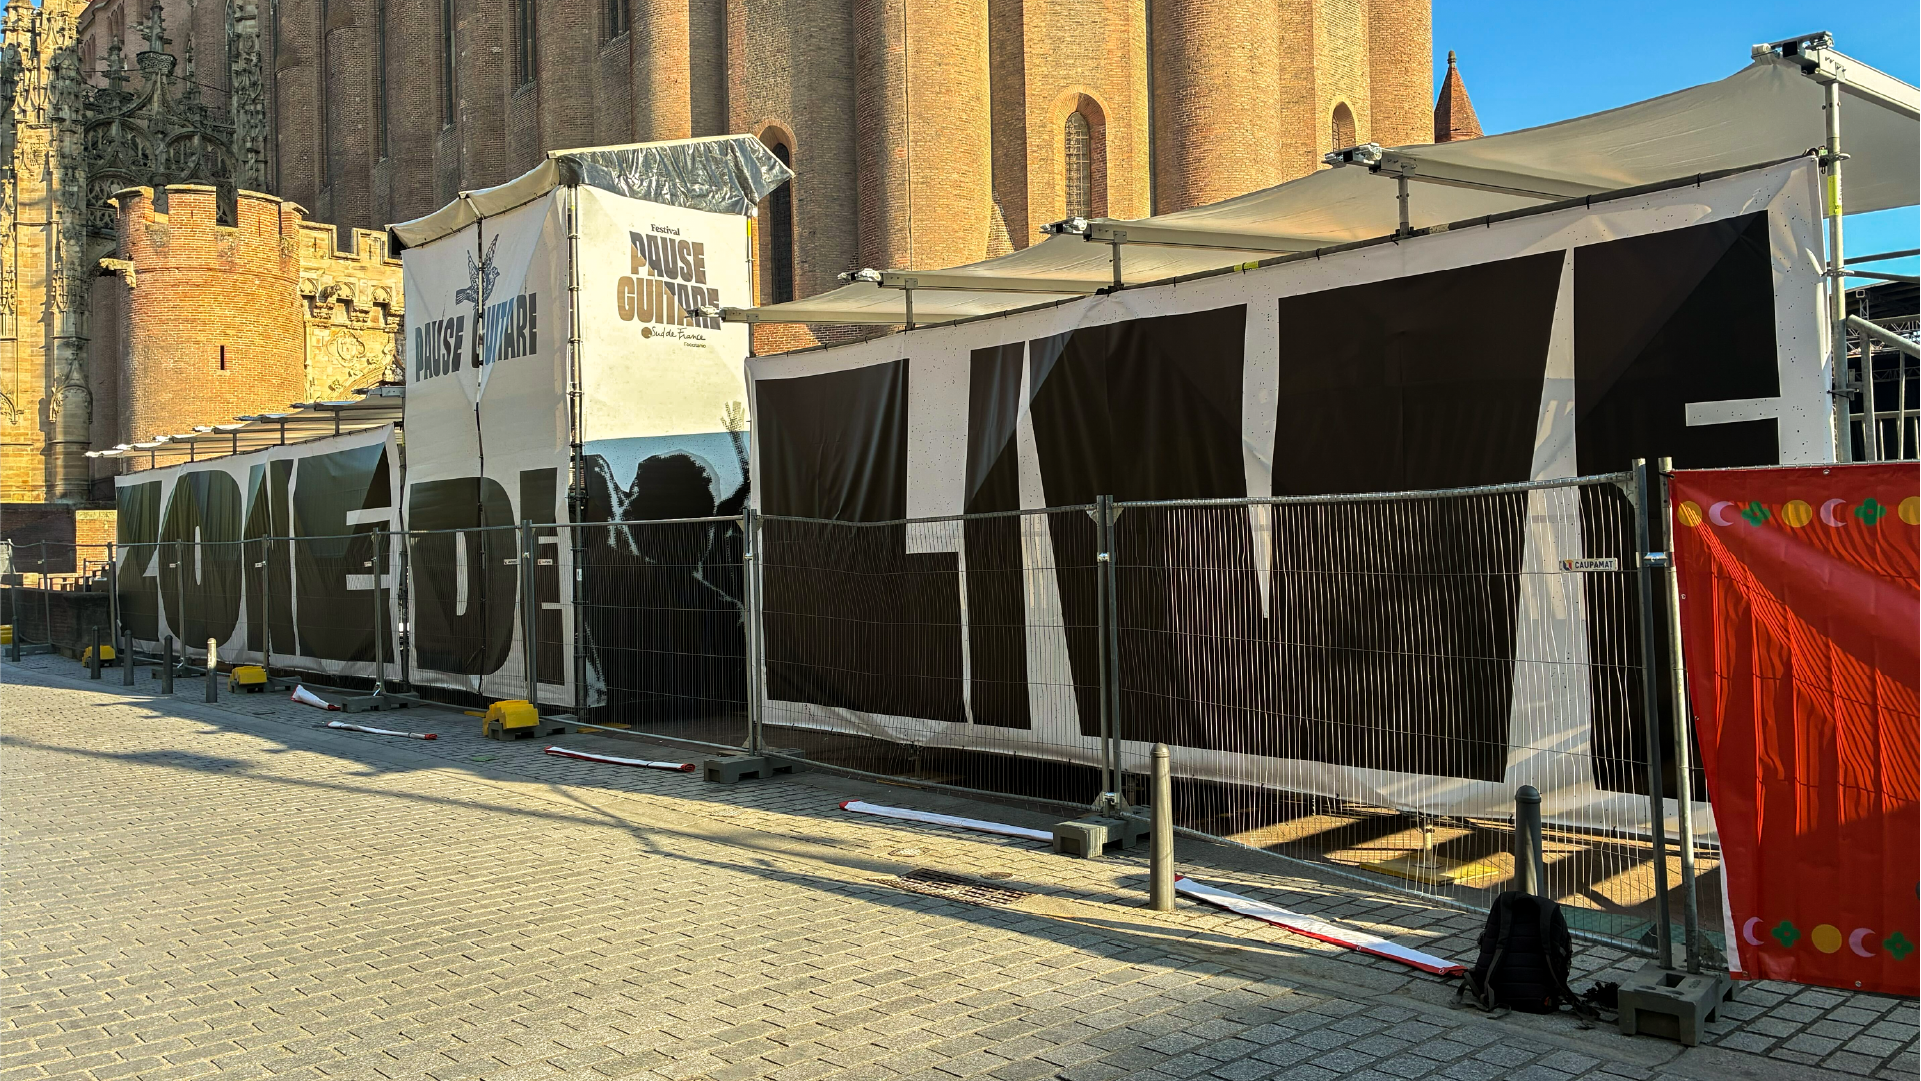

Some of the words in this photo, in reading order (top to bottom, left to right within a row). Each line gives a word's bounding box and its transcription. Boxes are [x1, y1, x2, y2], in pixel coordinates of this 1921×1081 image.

[651, 224, 680, 235] Festival
[629, 231, 706, 285] PAUSE
[617, 276, 721, 330] GUITARE
[415, 315, 465, 383] PAUSE
[471, 292, 537, 368] GUITARE
[651, 326, 666, 338] Sud
[677, 327, 707, 341] France
